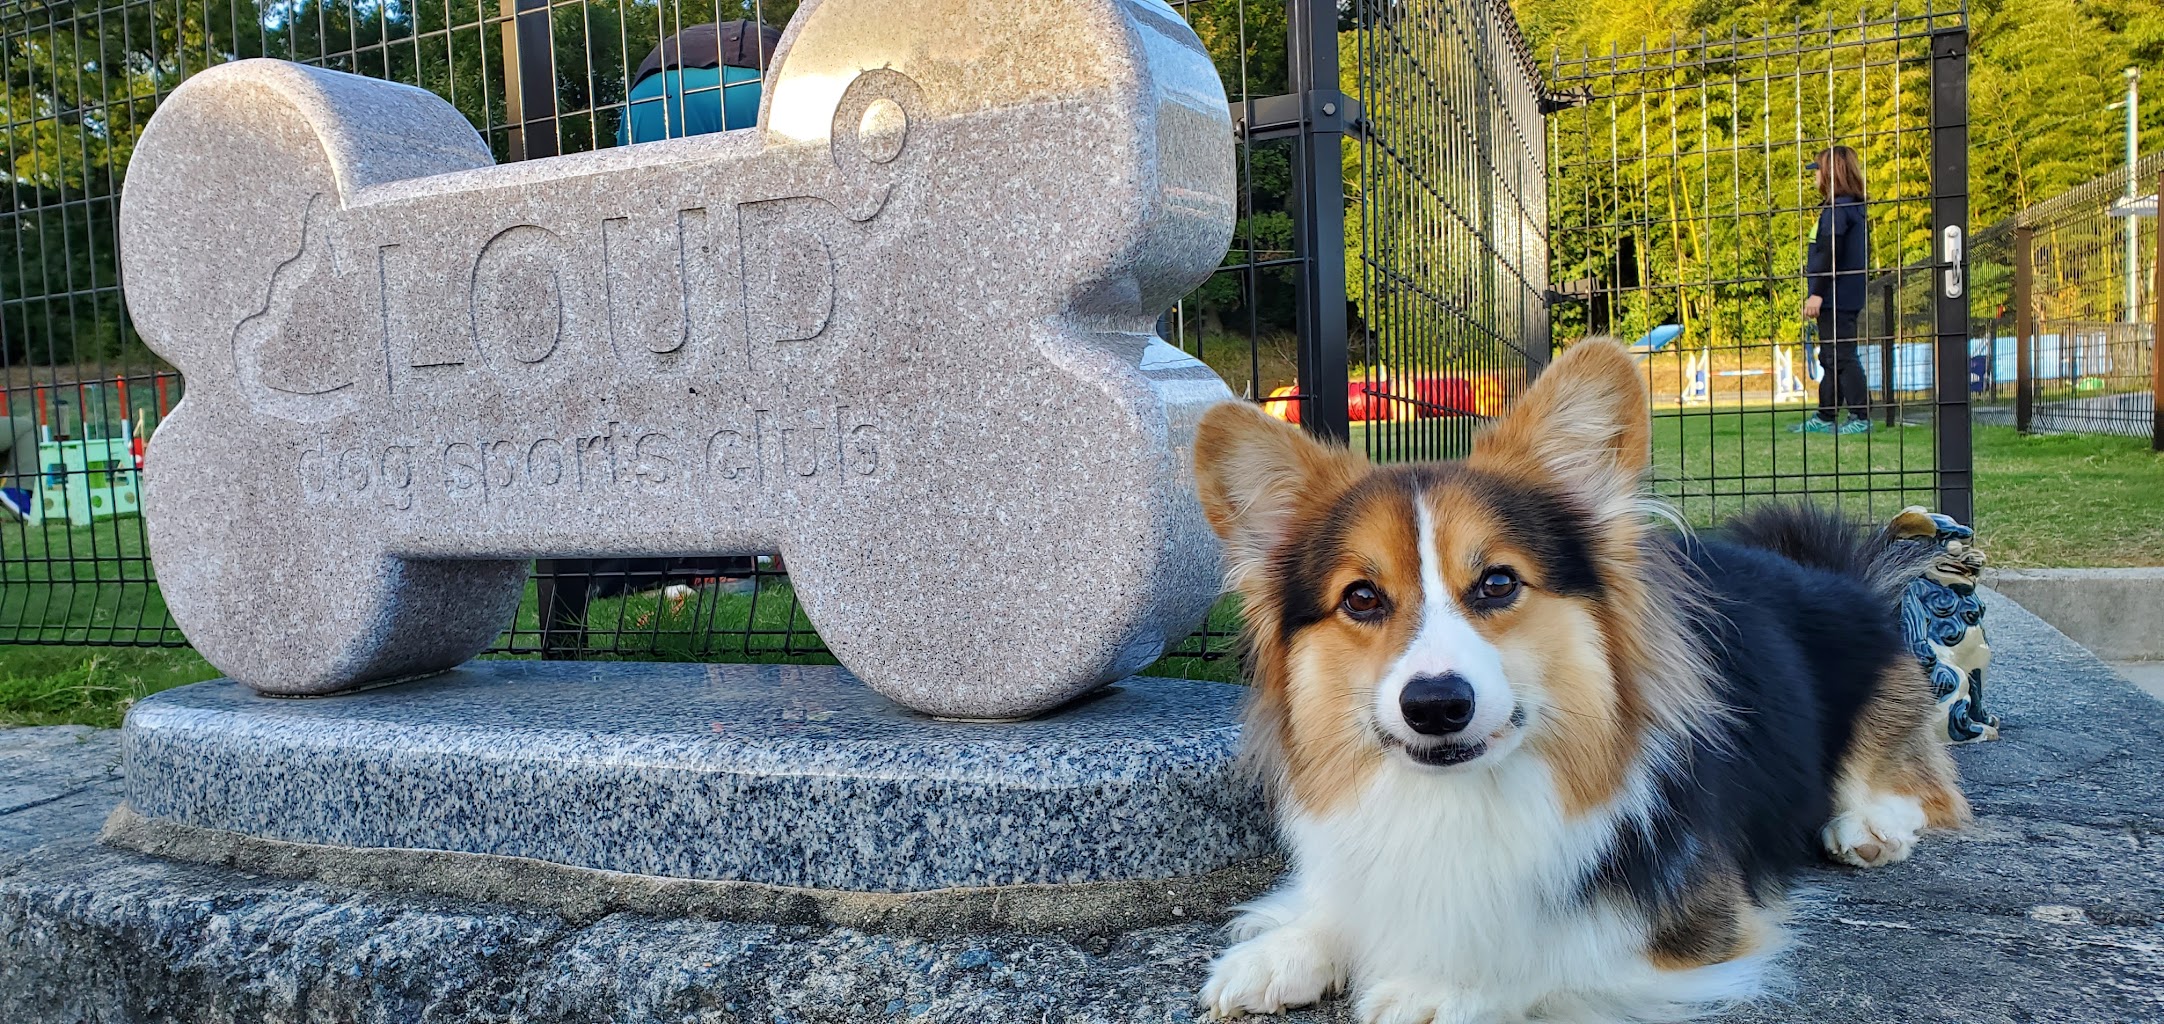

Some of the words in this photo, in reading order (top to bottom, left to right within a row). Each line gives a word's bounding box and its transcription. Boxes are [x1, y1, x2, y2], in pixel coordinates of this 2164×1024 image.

[297, 431, 416, 513] dog
[443, 421, 678, 516] sports
[705, 405, 884, 490] club
